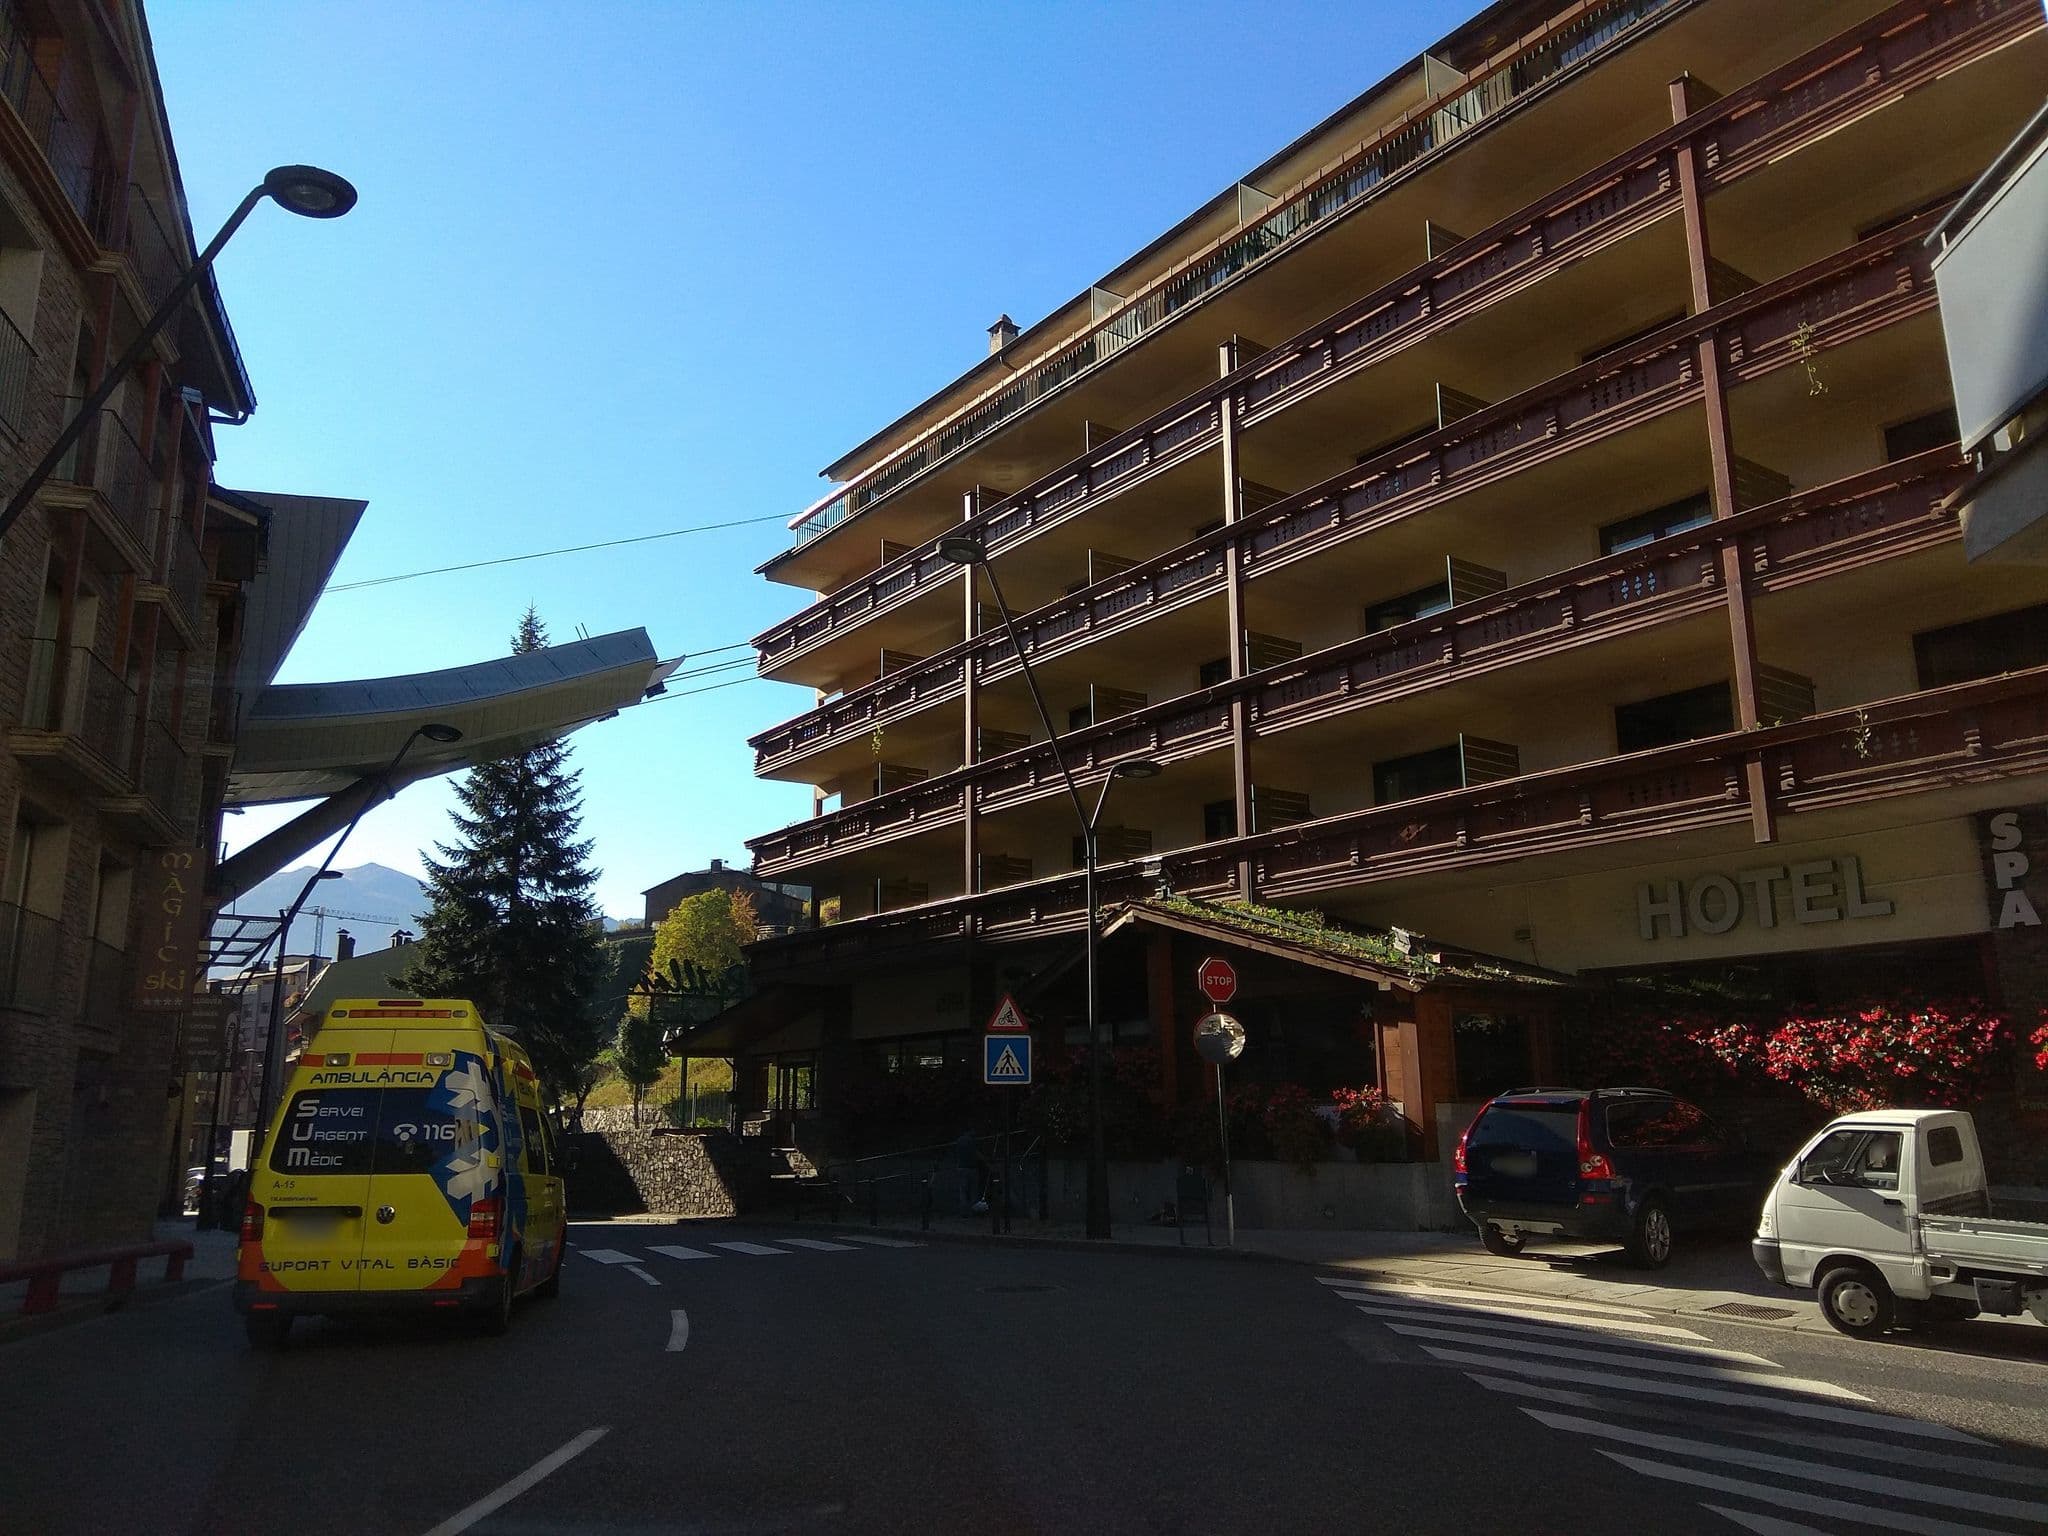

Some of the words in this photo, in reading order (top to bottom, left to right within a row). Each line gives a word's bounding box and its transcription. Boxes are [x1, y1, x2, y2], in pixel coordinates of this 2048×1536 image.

[1989, 812, 2042, 930] SPA
[1637, 855, 1895, 940] HOTEL
[1206, 975, 1232, 986] STOP
[310, 1067, 435, 1085] AMBULÀNCIA
[423, 1123, 456, 1141] 116
[272, 1180, 296, 1190] A-15
[258, 1259, 332, 1273] SUPORT
[341, 1258, 395, 1271] VITAL
[407, 1255, 461, 1270] BÀSIC
